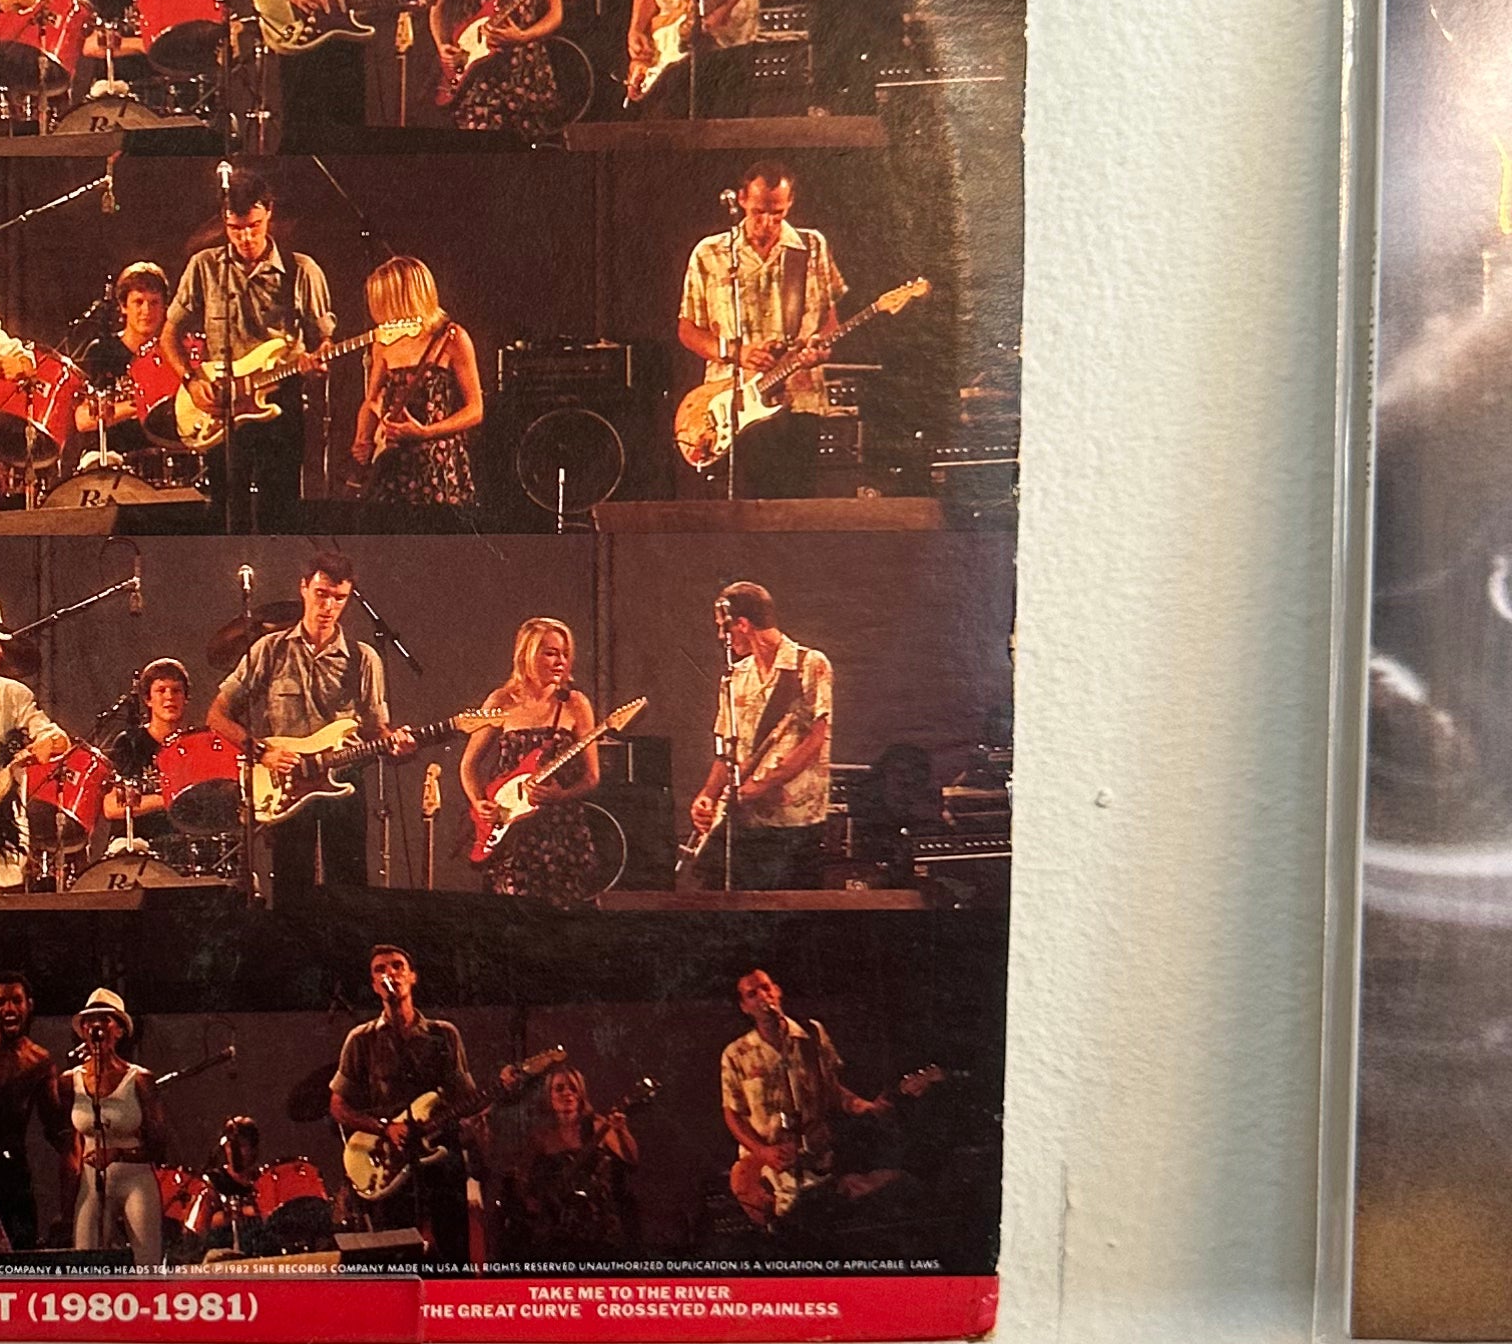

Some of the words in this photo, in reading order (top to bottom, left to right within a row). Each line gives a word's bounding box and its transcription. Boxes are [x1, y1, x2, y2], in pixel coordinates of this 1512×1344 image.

[55, 1265, 62, 1275] &
[65, 1265, 111, 1275] TALKING
[114, 1265, 150, 1275] HEADS
[153, 1264, 188, 1275] TOURS
[190, 1264, 210, 1274] INC
[252, 1264, 275, 1274] SIRE
[278, 1263, 328, 1274] RECORDS
[331, 1263, 384, 1274] COMPANY
[387, 1263, 419, 1273] MADE
[421, 1263, 434, 1273] IN
[437, 1262, 459, 1273] USA
[462, 1262, 480, 1273] ALL
[483, 1262, 521, 1273] RIGHTS
[524, 1262, 576, 1272] RESERVED
[578, 1261, 664, 1272] UNAUTHORIZED
[666, 1260, 738, 1272] DUPLICATION
[740, 1260, 750, 1271] IS
[753, 1260, 762, 1271] A
[764, 1260, 823, 1271] VIOLATION
[825, 1260, 839, 1271] OF
[843, 1259, 905, 1271] APPLICABLE
[528, 1285, 574, 1301] TAKE
[577, 1285, 605, 1301] ME
[608, 1285, 633, 1301] TO
[635, 1285, 671, 1301] THE
[674, 1285, 731, 1300] RIVER
[27, 1291, 259, 1323] (1980-1981)
[419, 1303, 455, 1319] THE
[457, 1303, 517, 1318] GREAT
[519, 1303, 583, 1318] CURVE
[596, 1302, 707, 1318] CROSSEYED
[709, 1302, 749, 1318] AND
[751, 1302, 840, 1317] PAINLESS
